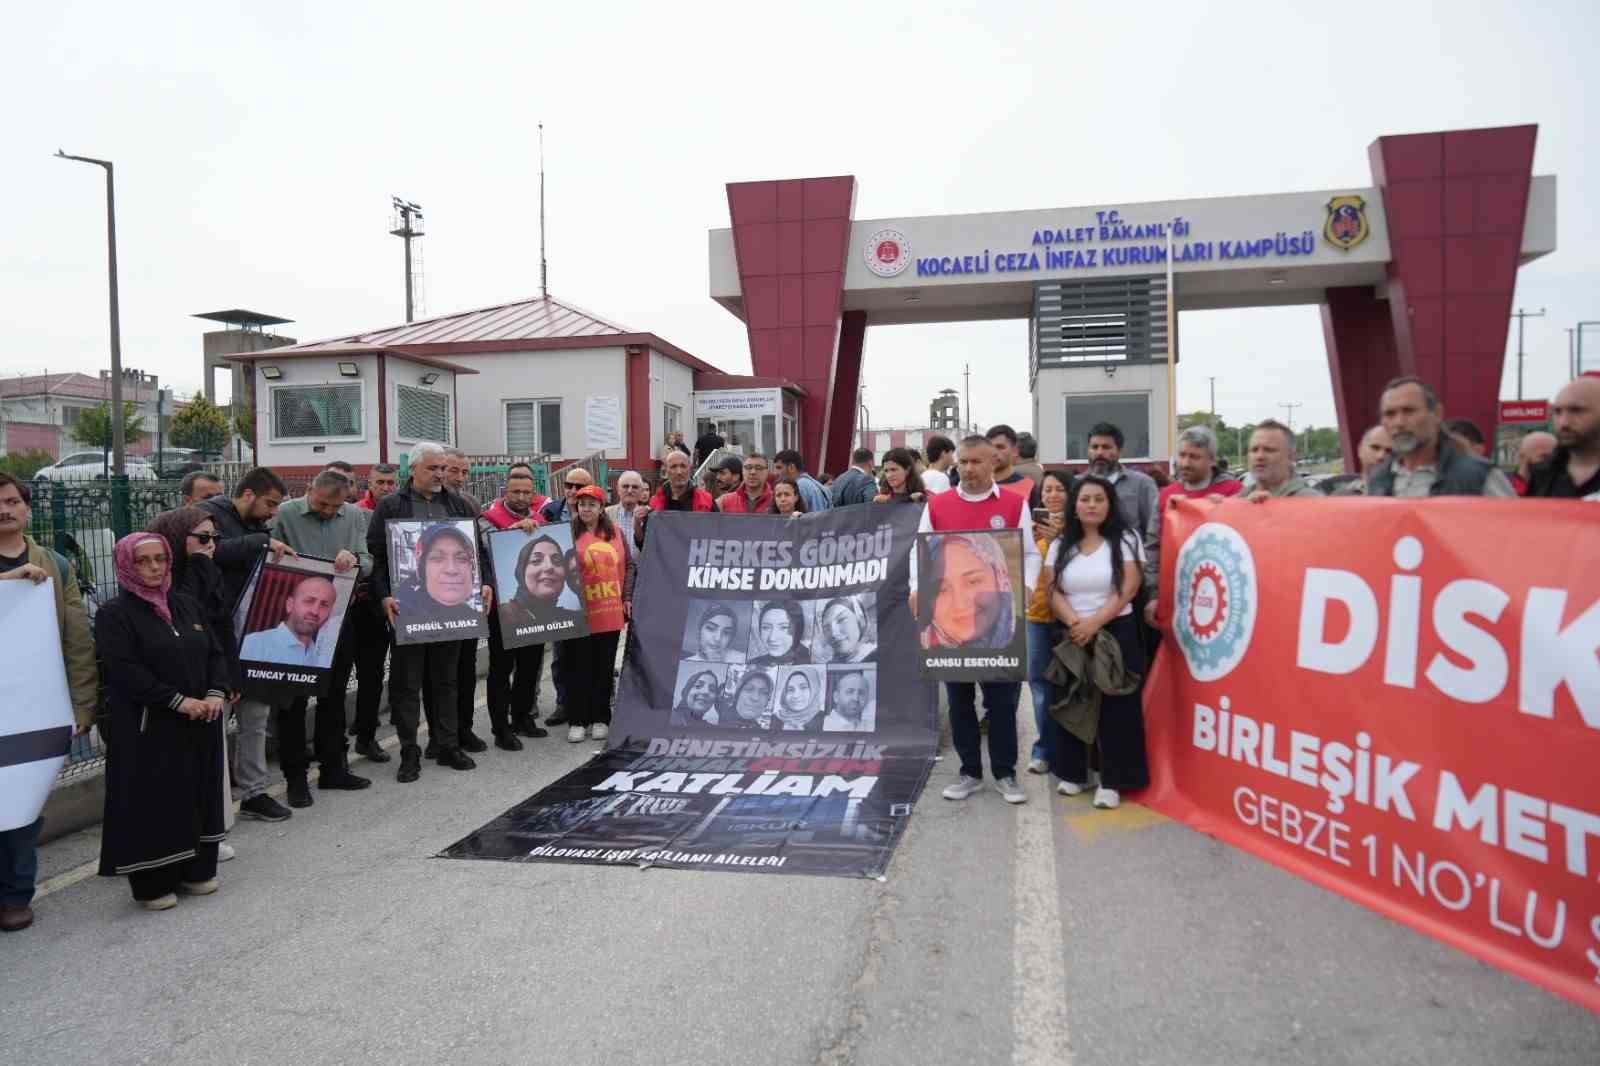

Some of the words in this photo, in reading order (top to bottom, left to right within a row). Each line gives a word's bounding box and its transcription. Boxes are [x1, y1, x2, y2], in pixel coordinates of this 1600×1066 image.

[1032, 227, 1095, 246] ADALET
[1099, 217, 1190, 241] BAKANLĞI
[1096, 211, 1124, 225] T.C.
[917, 250, 990, 277] KOCAELİ
[995, 252, 1040, 272] CEZA
[1046, 246, 1097, 270] İNFAZ
[1103, 241, 1214, 267] KURUMLARI
[1220, 229, 1315, 260] KAMPÜSÜ
[688, 539, 793, 567] HERKES
[799, 523, 894, 568] GÖRDÜ
[687, 563, 756, 591] KİMSE
[759, 558, 888, 591] DOKUNMADI
[444, 618, 478, 629] YILMAZ
[515, 624, 545, 636] HANIM
[1296, 535, 1600, 731] DİSK
[926, 658, 962, 668] CANSU
[964, 655, 1019, 668] ESETOĞLU
[247, 669, 285, 681] TUNCAY
[287, 673, 318, 684] YILDIZ
[648, 737, 888, 760] DENETİMSİZLİK
[591, 769, 879, 798] KATLİAM
[1192, 696, 1423, 821] BİRLEŞİK
[1433, 769, 1600, 877] MET
[1233, 786, 1351, 867] GEBZE
[1361, 834, 1377, 877] 1
